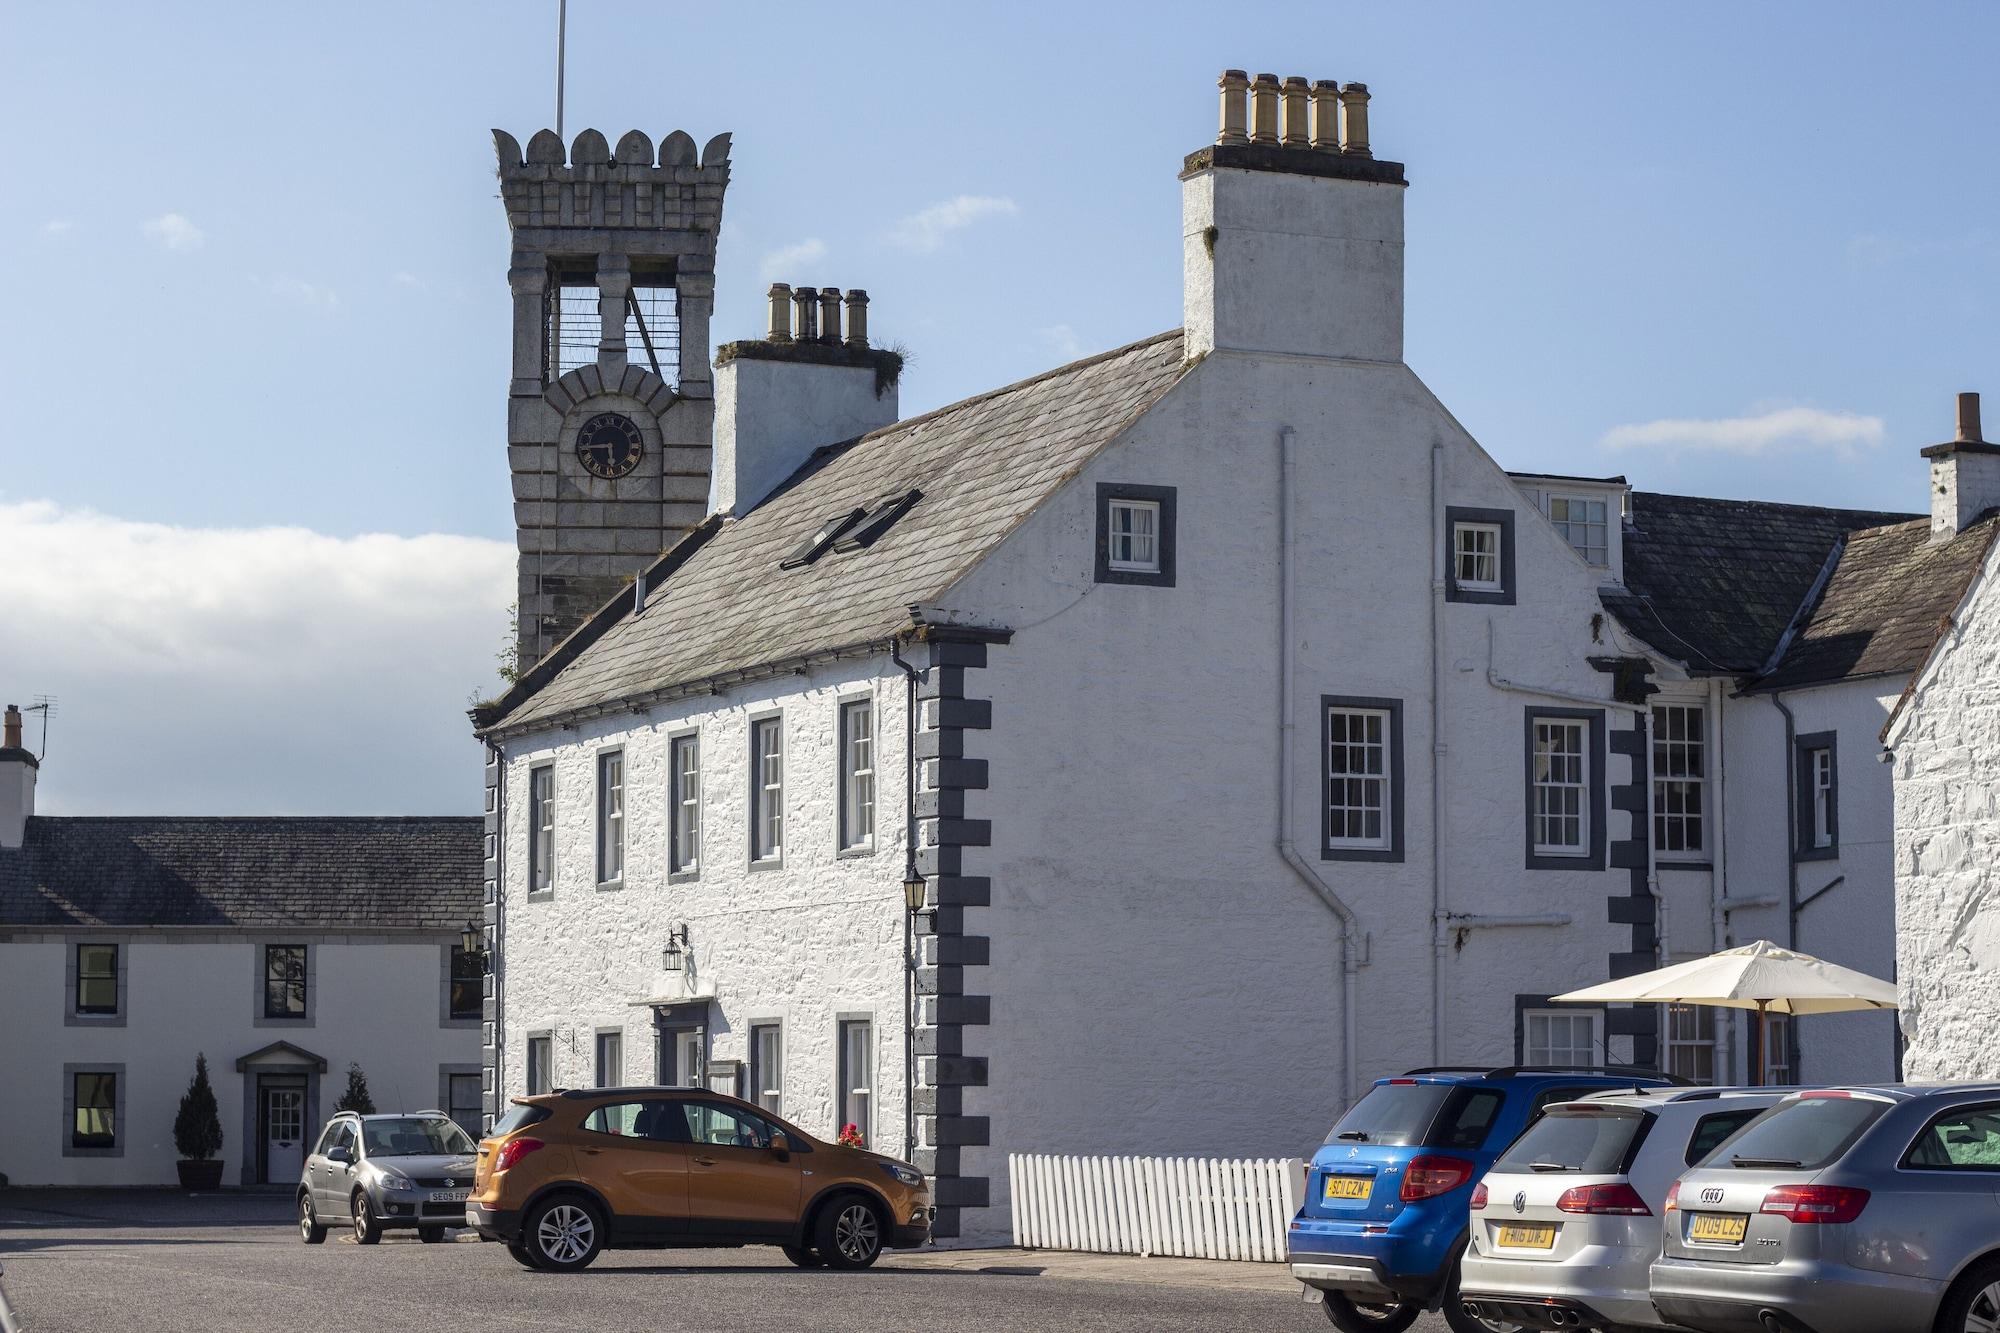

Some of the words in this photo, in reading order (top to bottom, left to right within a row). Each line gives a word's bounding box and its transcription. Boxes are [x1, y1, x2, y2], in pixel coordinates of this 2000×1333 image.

[1331, 1180, 1346, 1195] SC11
[1346, 1181, 1365, 1196] CZM
[432, 1192, 454, 1201] SE09
[1694, 1215, 1721, 1235] OY09
[1722, 1217, 1745, 1236] LZS
